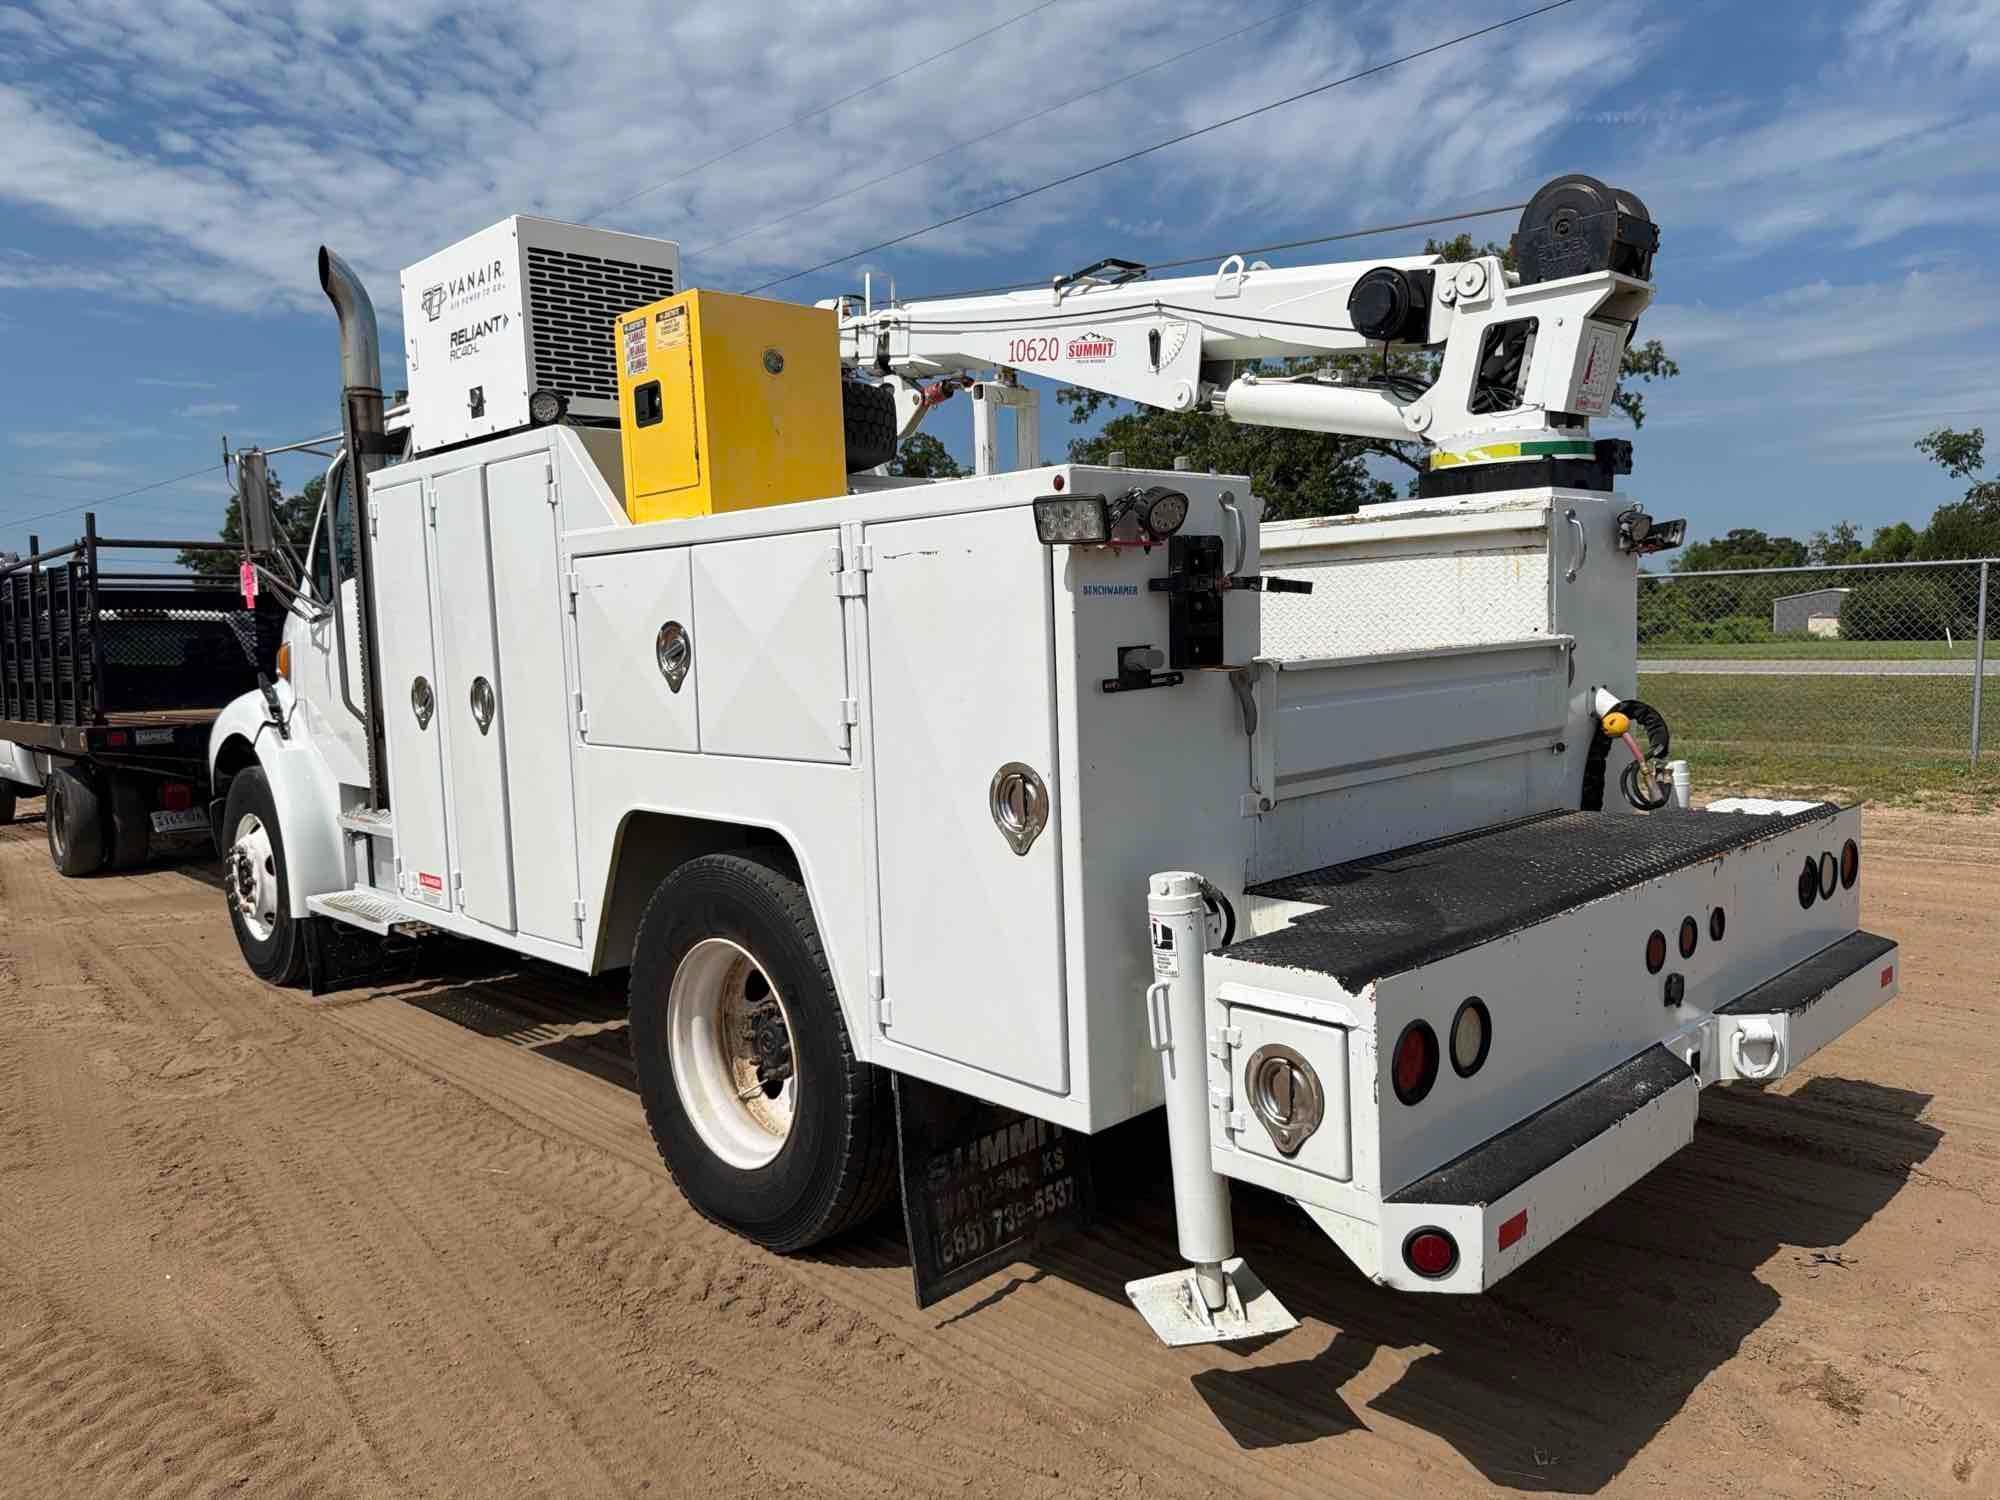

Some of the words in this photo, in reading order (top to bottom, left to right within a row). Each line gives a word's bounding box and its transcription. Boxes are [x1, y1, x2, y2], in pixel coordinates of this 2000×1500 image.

[449, 260, 502, 297] VANAIR
[450, 314, 502, 348] RELIANT
[1008, 336, 1059, 362] 10620
[1068, 342, 1114, 358] SUMMIT
[1083, 584, 1138, 595] BENCHWARMER
